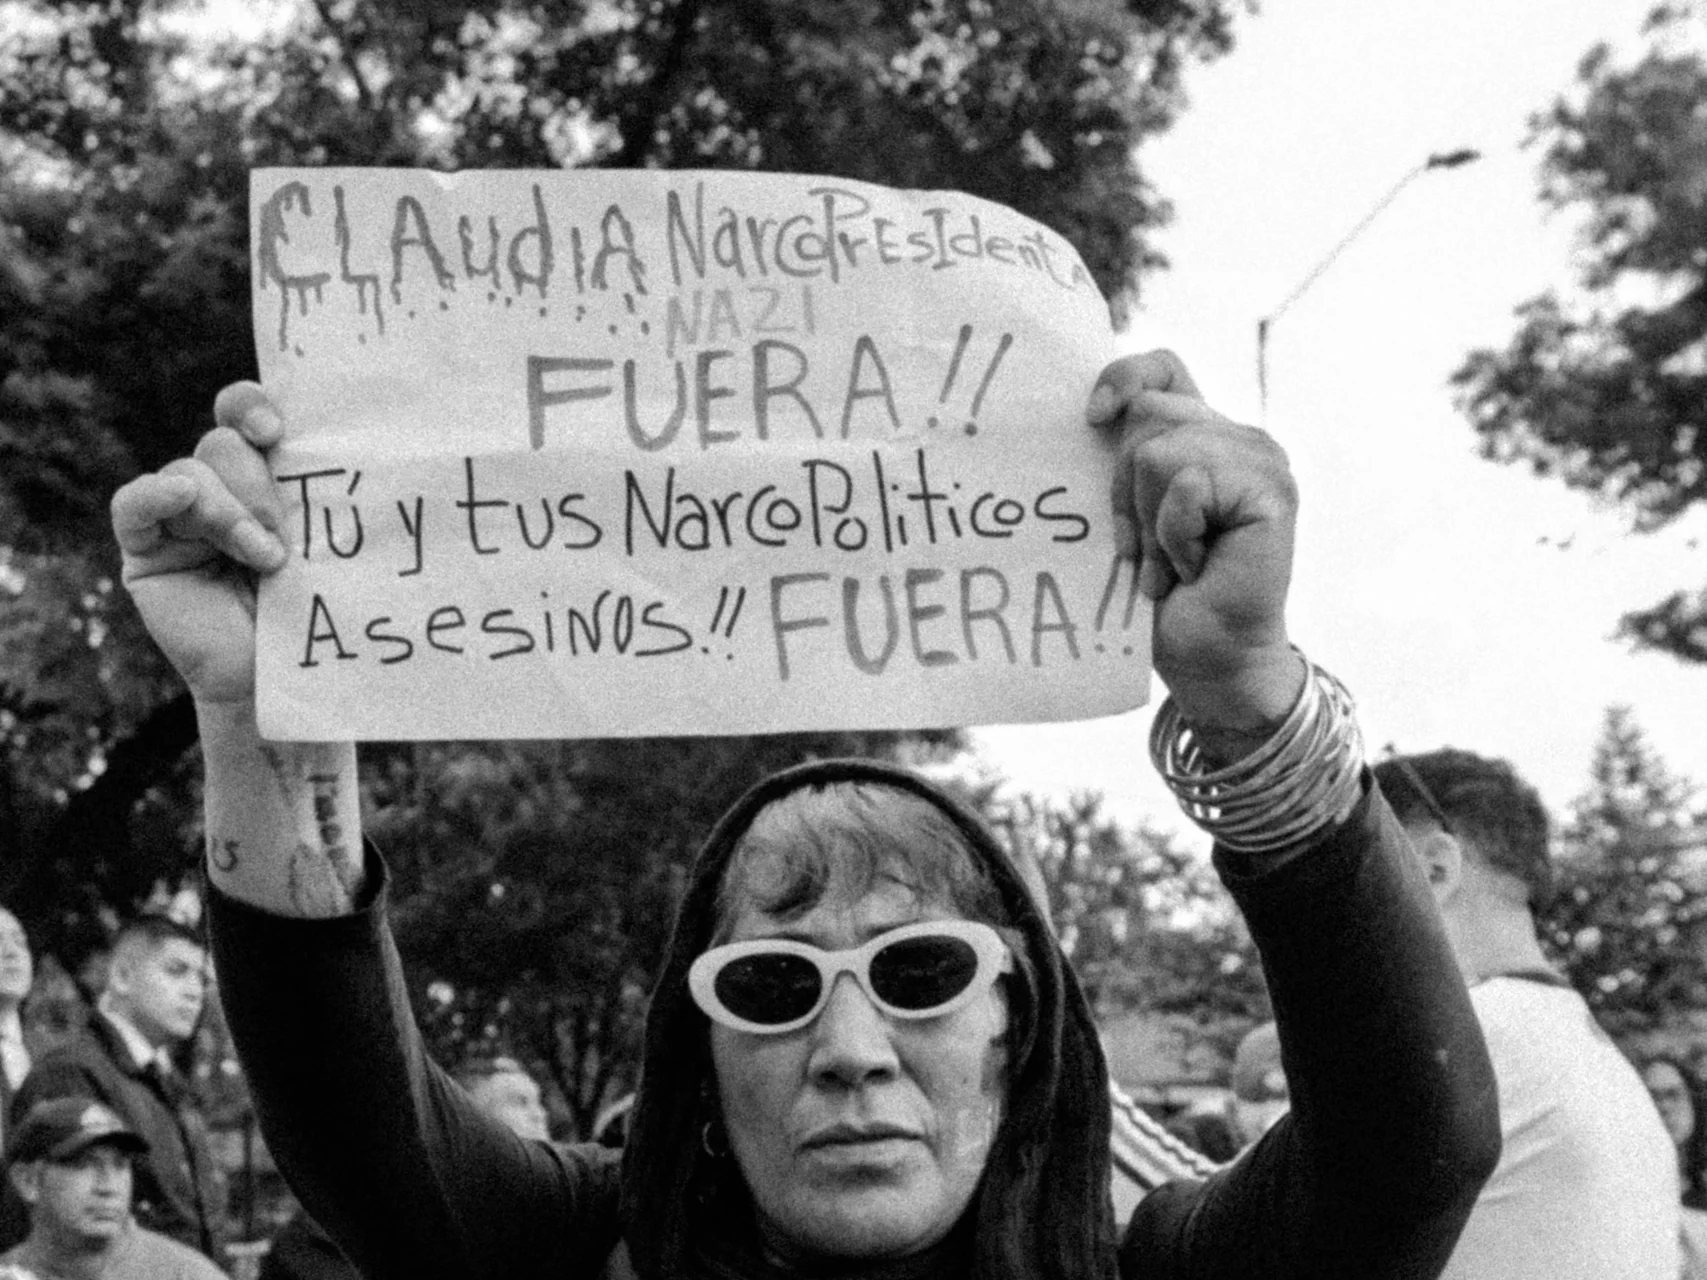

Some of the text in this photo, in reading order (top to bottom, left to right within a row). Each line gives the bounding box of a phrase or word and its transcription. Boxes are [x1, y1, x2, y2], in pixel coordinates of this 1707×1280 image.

[666, 285, 816, 358] NAZI
[276, 468, 364, 560] Tú
[397, 496, 424, 577] y
[456, 456, 603, 555] tus
